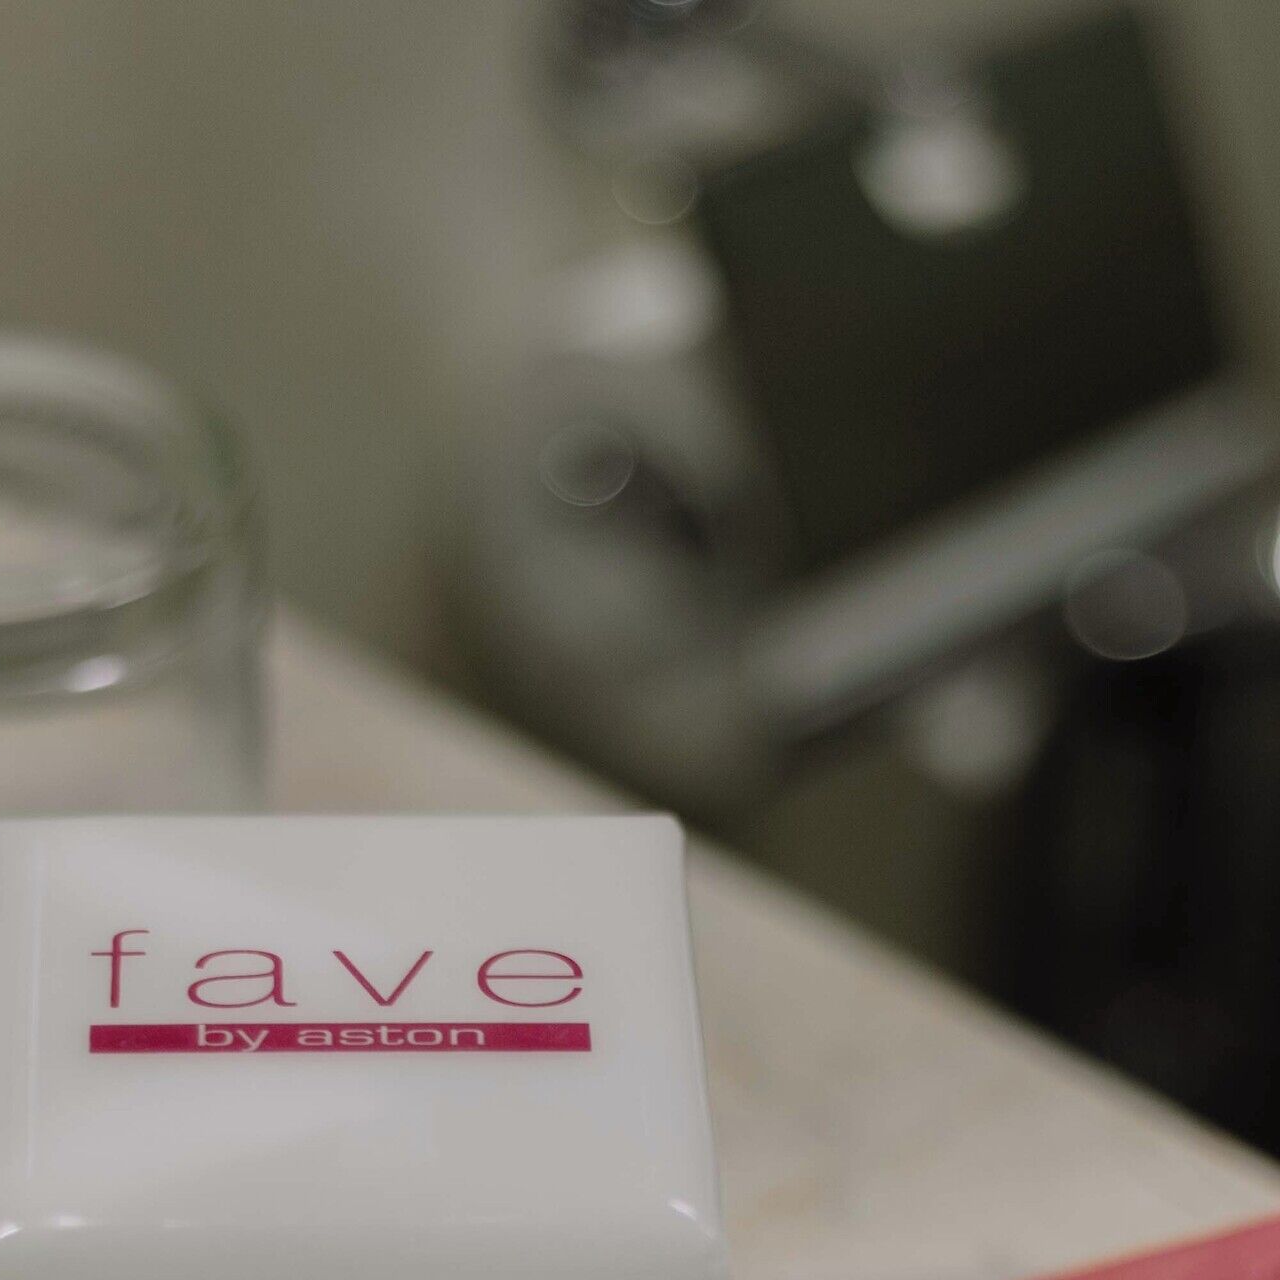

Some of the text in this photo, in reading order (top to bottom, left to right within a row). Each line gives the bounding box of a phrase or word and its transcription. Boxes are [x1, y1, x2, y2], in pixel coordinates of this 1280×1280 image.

[90, 929, 585, 1009] fave
[196, 1024, 487, 1052] by aston
